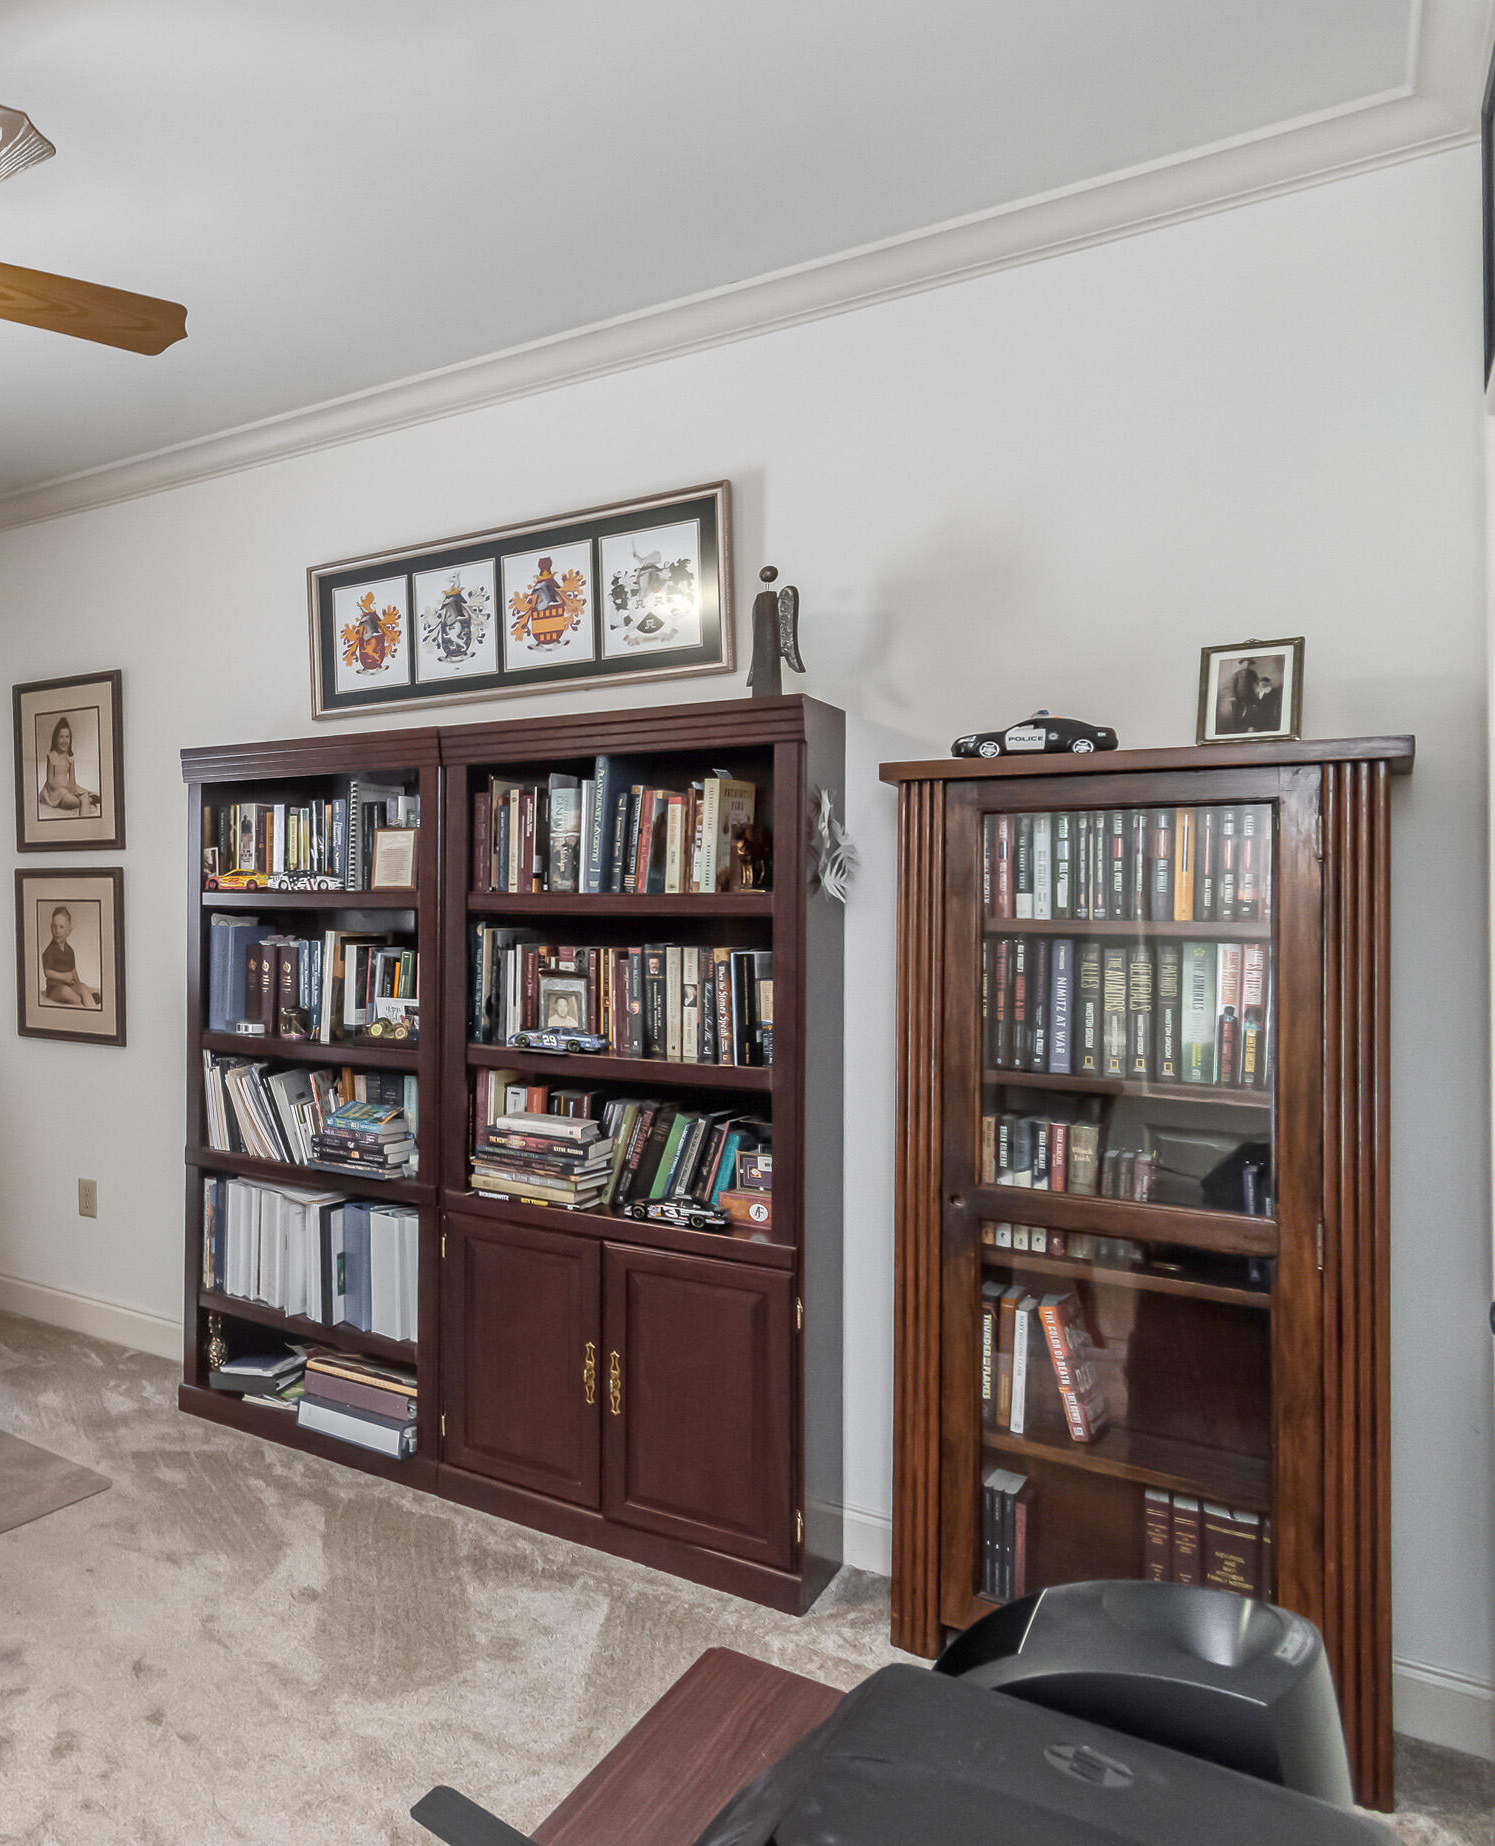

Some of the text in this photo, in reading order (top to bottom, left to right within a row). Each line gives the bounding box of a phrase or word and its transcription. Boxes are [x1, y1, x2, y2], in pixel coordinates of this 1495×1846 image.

[592, 768, 605, 863] PLANTAGENET ANCESTRY
[1114, 861, 1123, 871] BILL
[1157, 859, 1167, 892] BILL O'REILLY
[1114, 872, 1123, 892] O'REILLY
[1224, 874, 1234, 884] BILL
[1244, 873, 1254, 884] BILL
[1224, 885, 1234, 903] O'REILLY
[1108, 958, 1123, 968] THE
[1081, 962, 1099, 989] ALLIES
[1130, 963, 1152, 1011] GENERALS
[1161, 965, 1177, 997] PATRIOTS
[1244, 949, 1263, 1005] JAMES PATTERSON
[719, 991, 728, 1014] Stones
[1056, 976, 1067, 1011] NIMITZ
[1105, 970, 1126, 1012] AVIATORS
[1192, 975, 1205, 1011] ADMIRALS
[719, 1015, 729, 1037] Speak
[1056, 1015, 1067, 1027] AT
[1085, 1002, 1094, 1027] WINSTON
[541, 1034, 558, 1047] 29
[1036, 1029, 1044, 1038] BILL
[1055, 1031, 1066, 1054] WAR
[1085, 1028, 1094, 1048] GROOM
[629, 1110, 653, 1169] FORTY-SEVEN DAYS
[1038, 1146, 1046, 1169] KILMEADE
[1044, 1311, 1056, 1324] THE
[983, 1314, 992, 1356] THUNDER
[1047, 1326, 1061, 1349] COLOR
[1054, 1349, 1064, 1361] OF
[1056, 1362, 1070, 1385] DEATH
